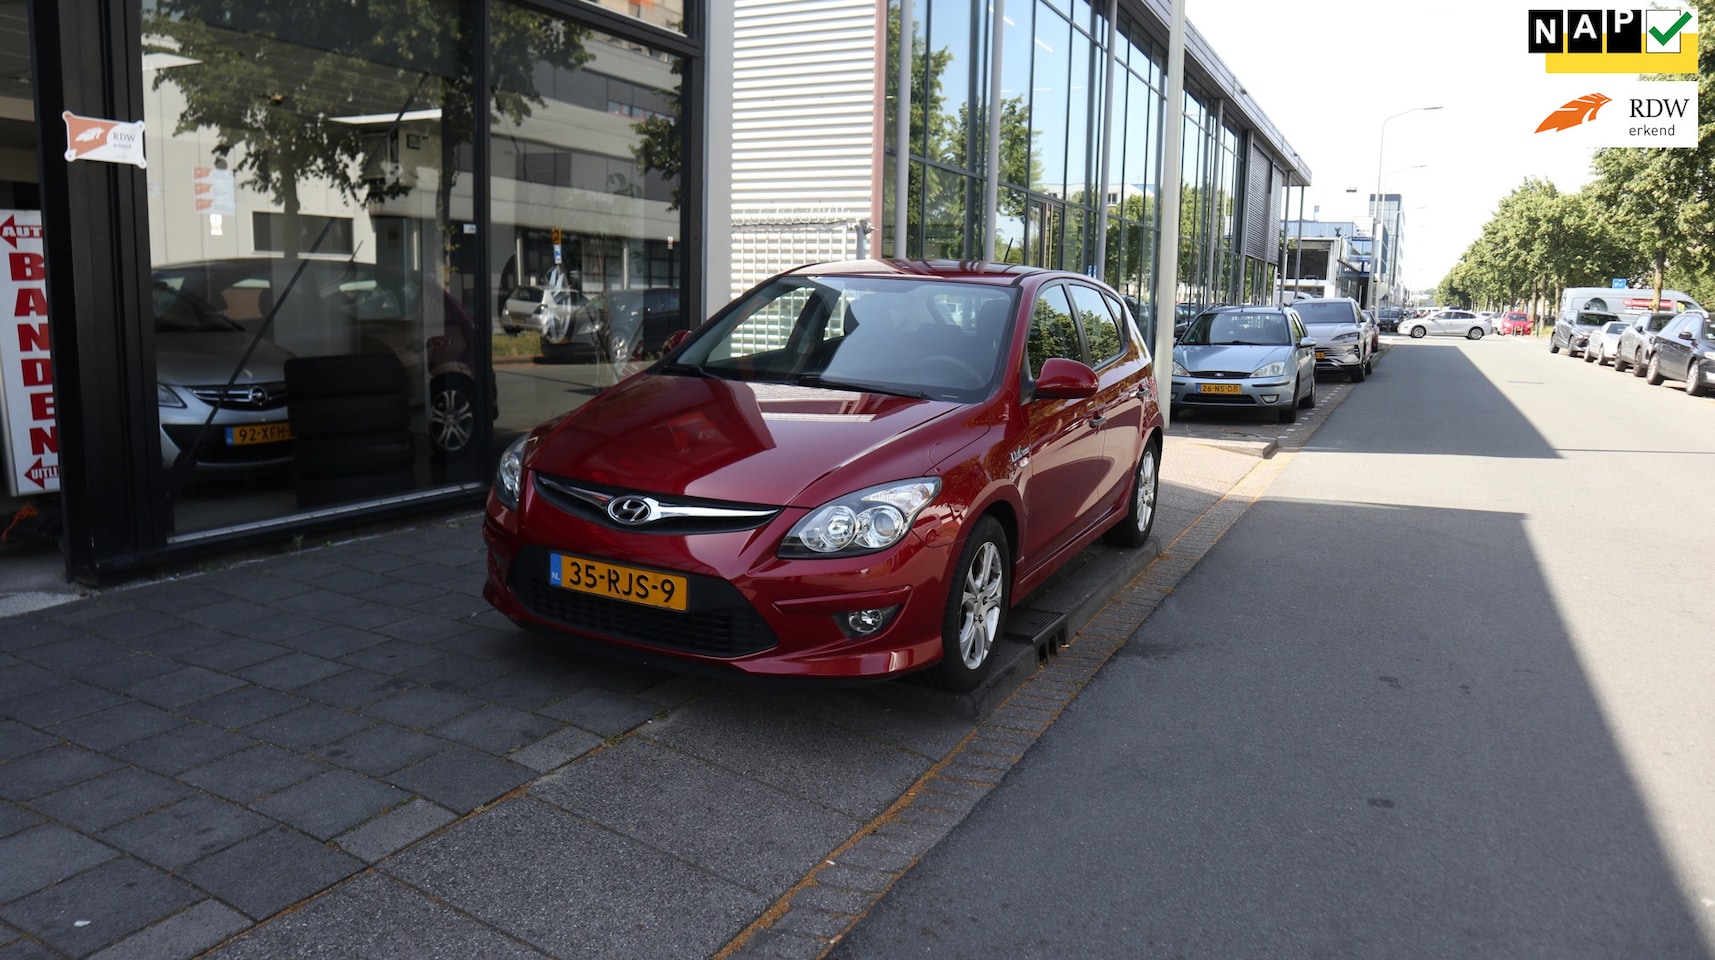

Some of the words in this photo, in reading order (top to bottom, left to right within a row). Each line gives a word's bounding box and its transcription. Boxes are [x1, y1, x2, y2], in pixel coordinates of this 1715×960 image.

[113, 131, 136, 143] RDW
[8, 252, 58, 456] BANDEN
[30, 466, 60, 480] UITLI
[551, 571, 561, 581] NL
[569, 561, 675, 603] 35-RJS-9
